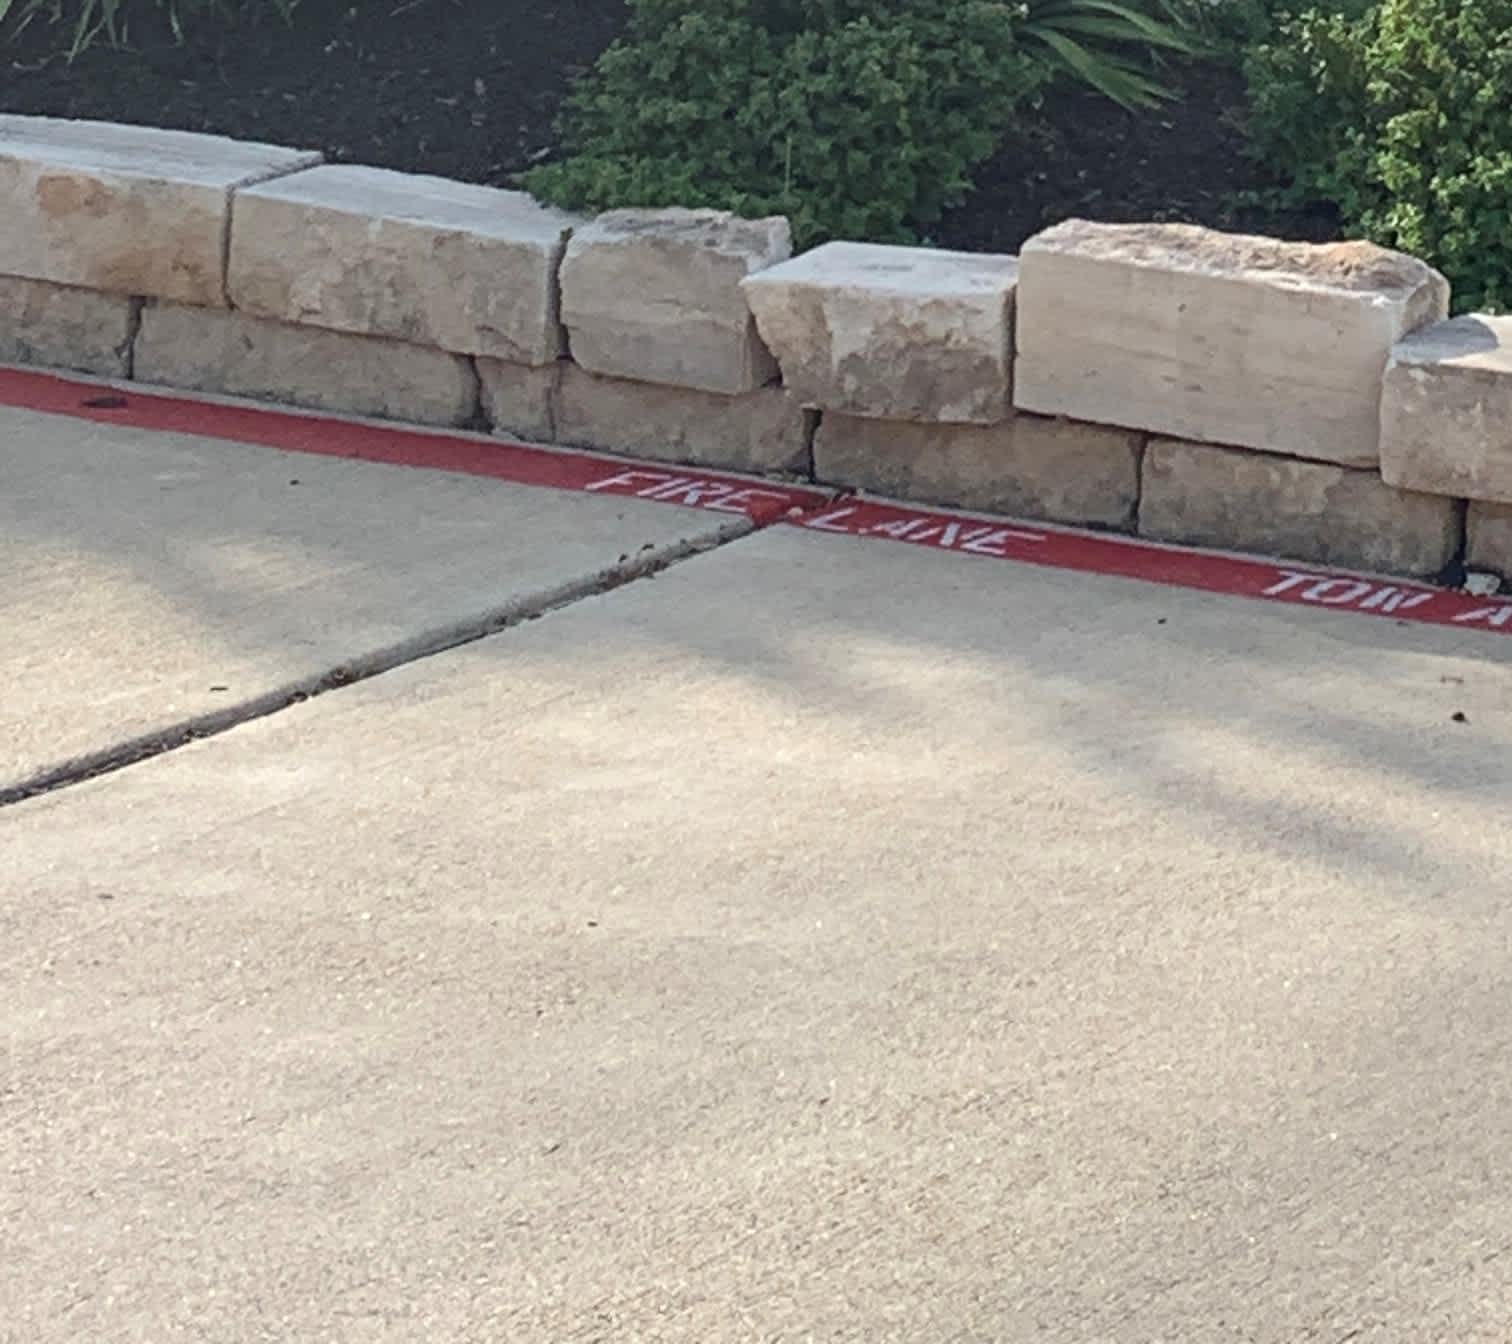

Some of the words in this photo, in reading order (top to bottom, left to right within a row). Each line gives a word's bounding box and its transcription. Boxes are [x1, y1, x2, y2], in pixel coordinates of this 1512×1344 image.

[584, 471, 790, 513] FIRE
[804, 506, 1046, 554] LANE
[1261, 570, 1433, 612] TOW
